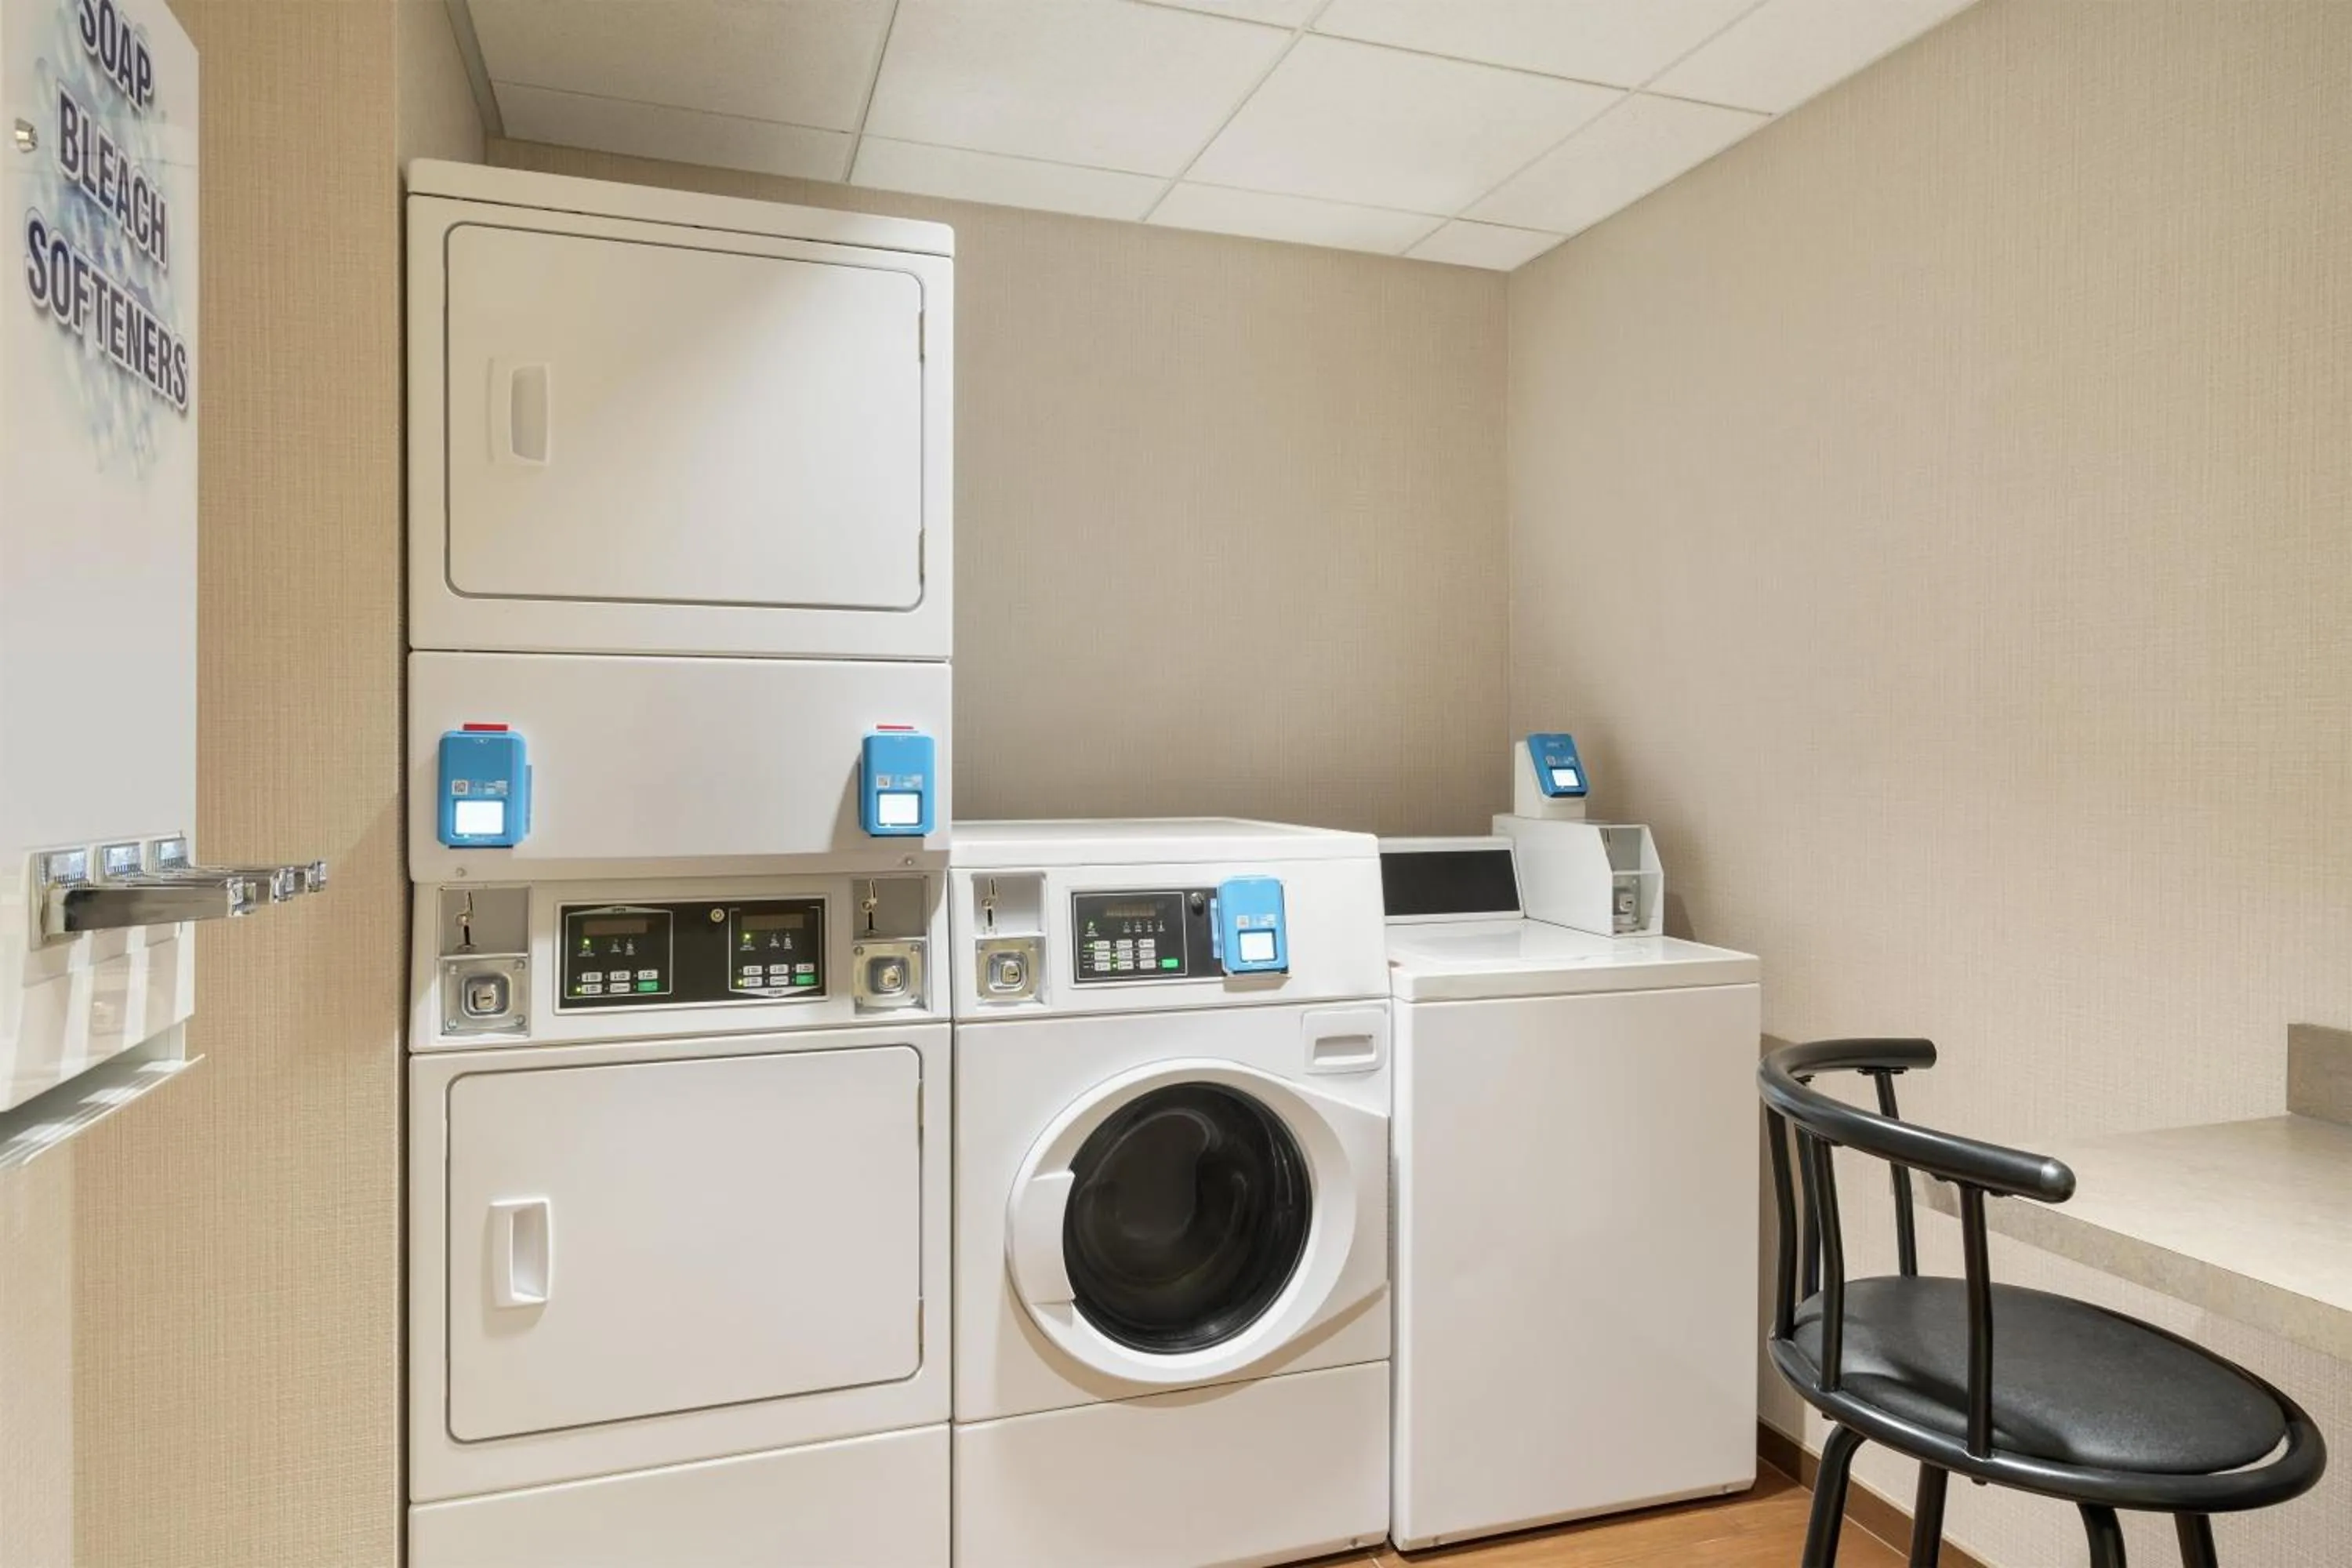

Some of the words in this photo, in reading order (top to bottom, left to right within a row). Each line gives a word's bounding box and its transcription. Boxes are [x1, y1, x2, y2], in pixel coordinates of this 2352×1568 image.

[79, 0, 151, 107] SOAP
[60, 91, 167, 267] BLEACH
[27, 220, 187, 406] SOFTENERS
